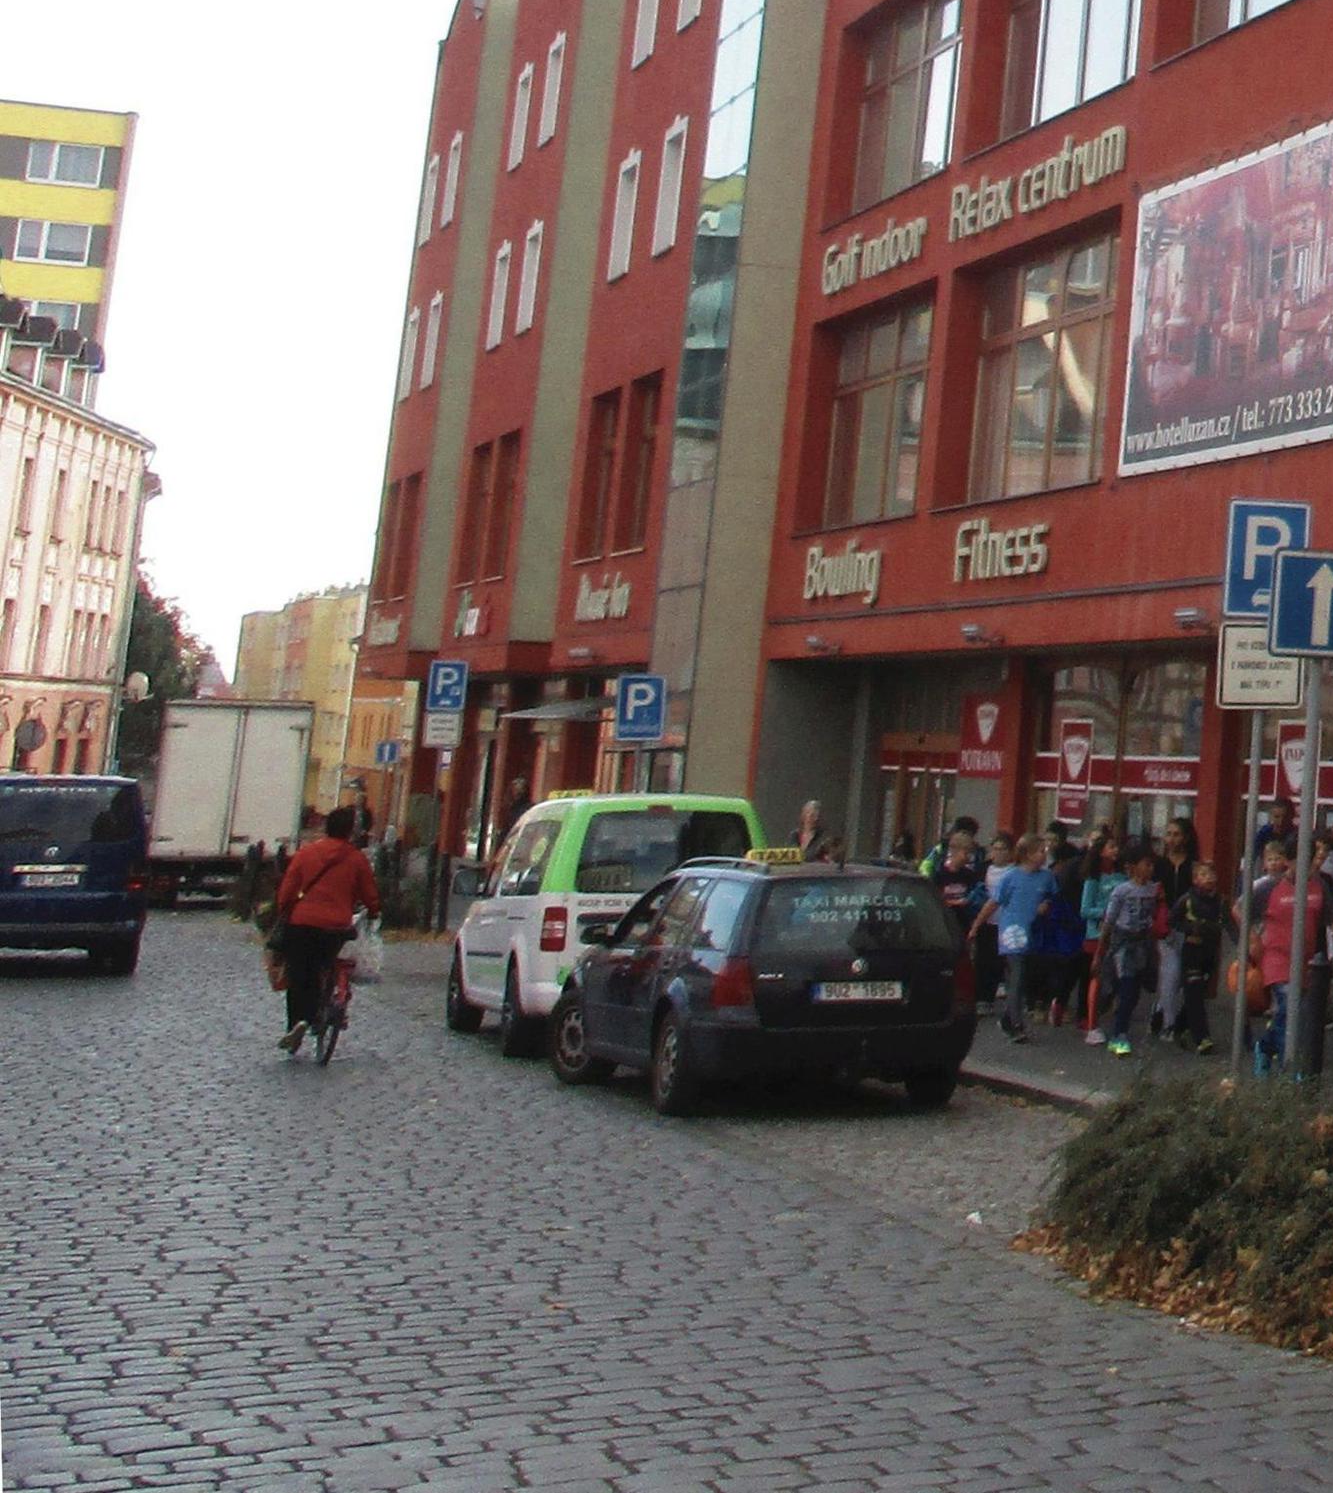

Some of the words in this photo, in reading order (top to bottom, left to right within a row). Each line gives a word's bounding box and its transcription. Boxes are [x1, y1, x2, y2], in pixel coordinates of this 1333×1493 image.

[948, 174, 1014, 244] Relax
[1017, 124, 1127, 214] centrum
[821, 231, 864, 296] Golf
[860, 216, 928, 280] indoor
[1268, 394, 1292, 427] 773
[1295, 387, 1323, 421] 333
[803, 538, 882, 607] Bowling
[953, 517, 1049, 583] Fitness
[1243, 516, 1291, 581] P
[435, 667, 459, 695] P
[625, 682, 656, 721] P
[757, 849, 797, 860] TAXI
[835, 894, 915, 907] MARCELA
